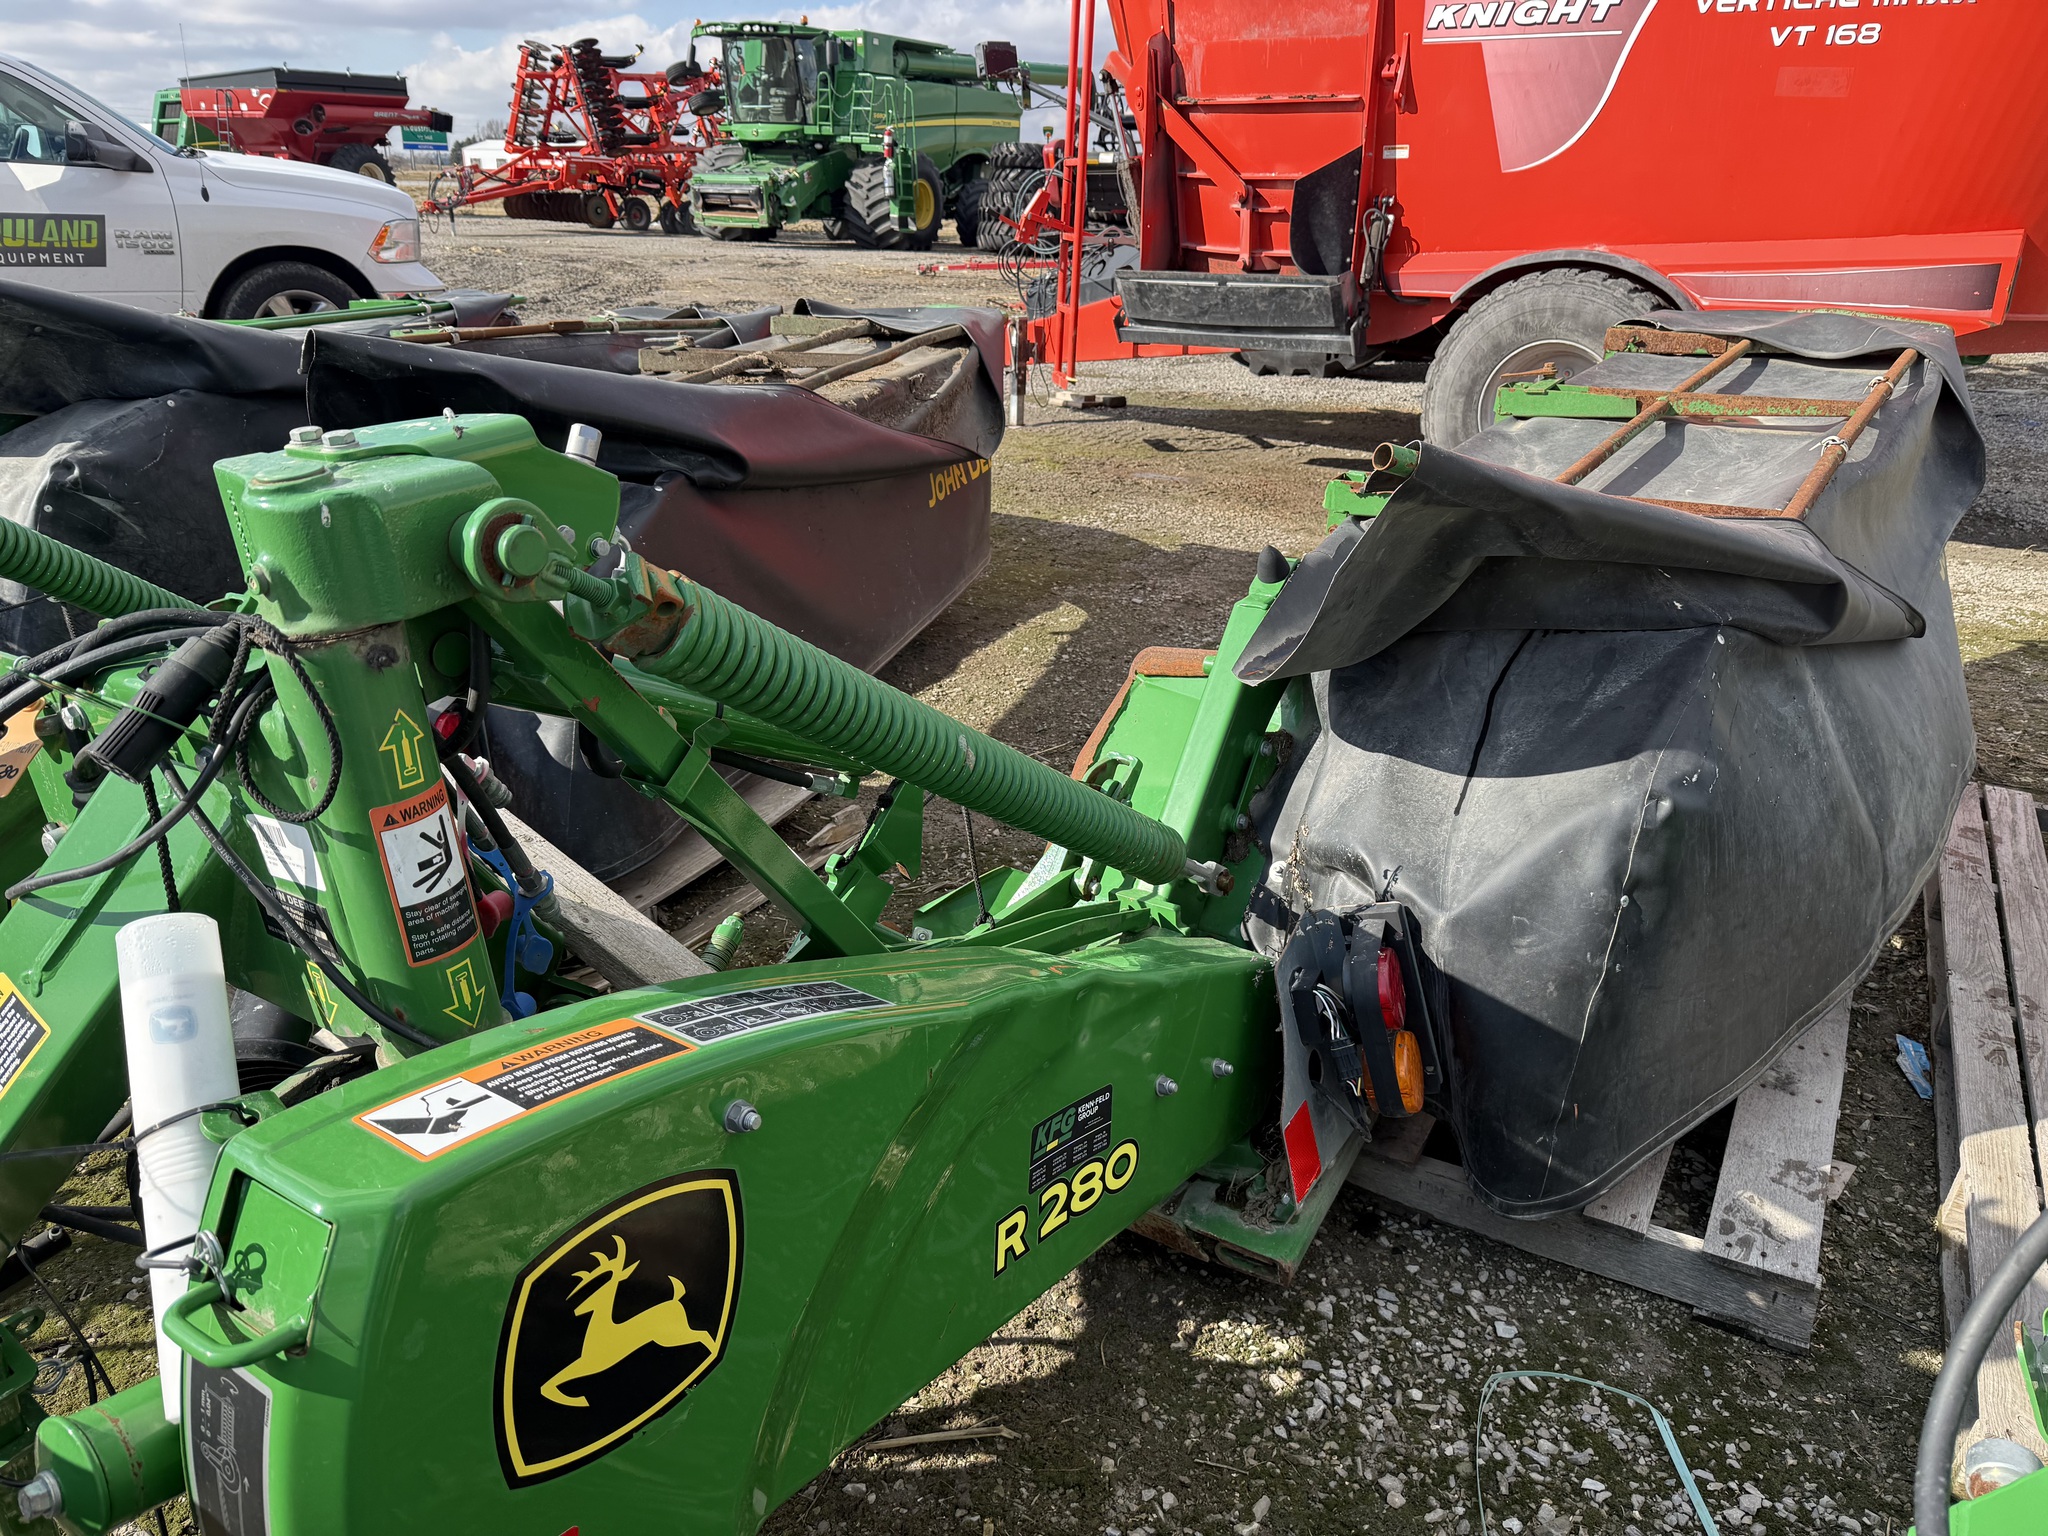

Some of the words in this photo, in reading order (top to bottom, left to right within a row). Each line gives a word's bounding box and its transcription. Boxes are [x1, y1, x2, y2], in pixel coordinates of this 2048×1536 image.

[1426, 0, 1622, 29] KNIGHT
[1770, 25, 1816, 47] VT
[1825, 23, 1882, 46] 168
[0, 218, 98, 248] ULAND
[114, 229, 173, 240] RAM
[116, 240, 174, 250] 1500
[0, 252, 85, 265] QUIPMENT
[929, 463, 968, 508] JOHN
[399, 789, 445, 823] WARNING
[286, 894, 317, 914] DEERE
[406, 910, 423, 918] Stay
[424, 902, 441, 913] clear
[442, 897, 448, 905] of
[408, 918, 425, 926] area
[411, 933, 429, 942] Stay
[437, 923, 450, 934] safe
[452, 909, 470, 926] distance
[413, 940, 430, 949] from
[432, 930, 457, 943] rotating
[416, 948, 436, 957] parts.
[486, 1074, 514, 1088] AVOID
[513, 1062, 544, 1077] INJURY
[544, 1053, 570, 1067] FROM
[568, 1038, 608, 1057] ROTATING
[606, 1032, 636, 1043] KNIVES
[513, 1030, 603, 1062] WARNING
[508, 1077, 533, 1089] Keep
[533, 1066, 560, 1080] hands
[561, 1059, 577, 1068] and
[577, 1052, 594, 1062] feet
[595, 1046, 616, 1057] away
[616, 1038, 637, 1048] while
[517, 1073, 556, 1091] machine
[556, 1069, 564, 1077] is
[564, 1059, 597, 1073] running
[524, 1084, 548, 1097] Shut
[548, 1078, 560, 1088] off
[562, 1070, 587, 1084] power
[587, 1064, 598, 1072] to
[534, 1093, 544, 1101] or
[544, 1086, 563, 1097] fold
[563, 1079, 576, 1088] for
[576, 1066, 616, 1083] transport
[1077, 1092, 1111, 1115] KENN-FELD
[1077, 1105, 1099, 1122] GROUP
[1034, 1107, 1077, 1152] KFG
[995, 1207, 1028, 1275] R
[1039, 1140, 1138, 1241] 280
[200, 1389, 204, 1407] mm
